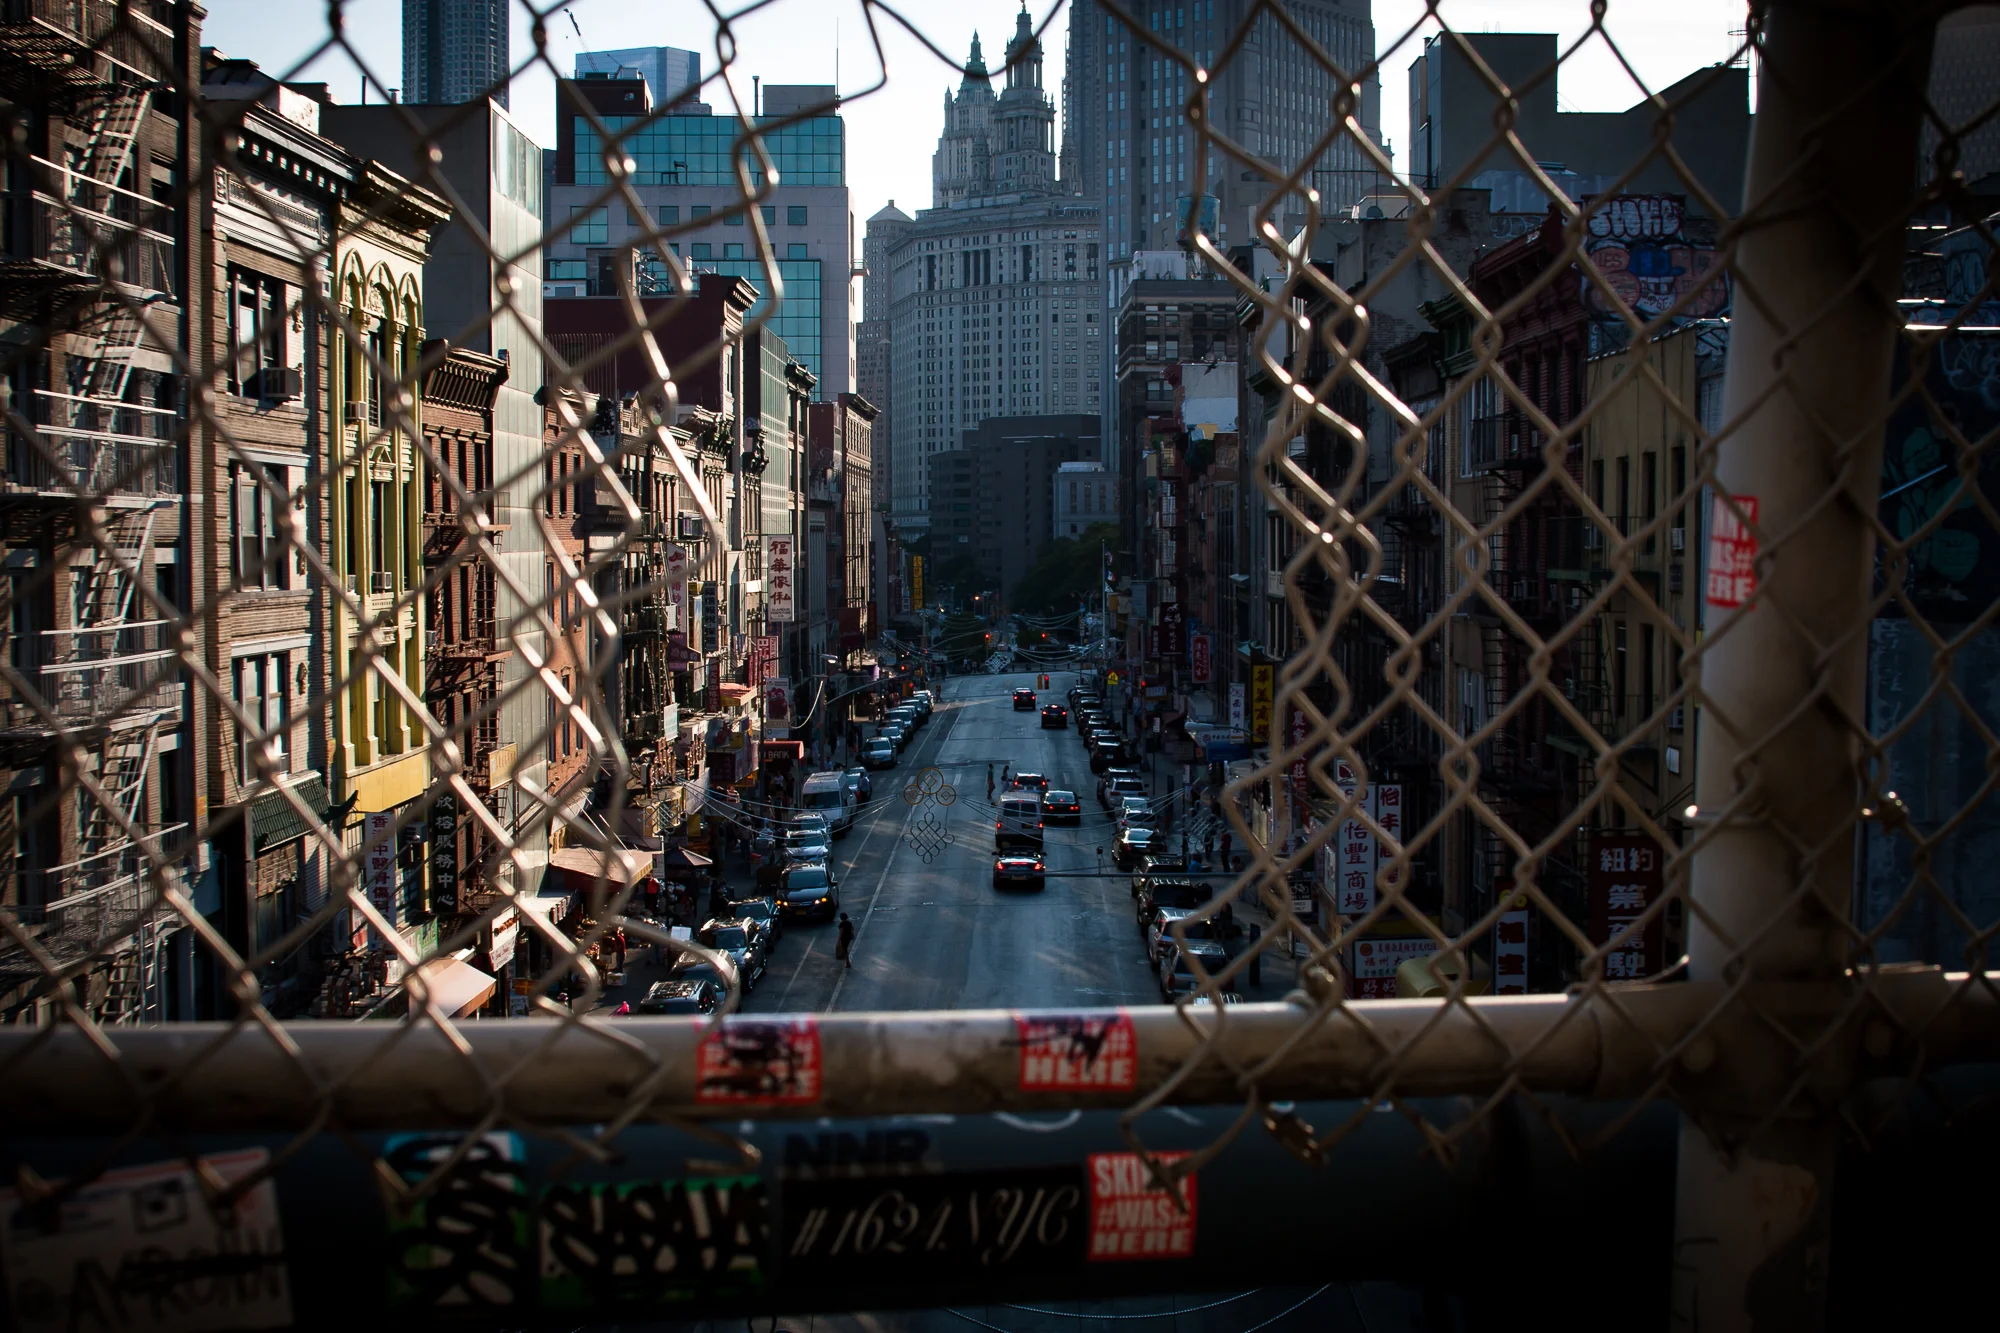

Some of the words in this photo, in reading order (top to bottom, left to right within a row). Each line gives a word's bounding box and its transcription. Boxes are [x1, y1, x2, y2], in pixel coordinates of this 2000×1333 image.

[768, 751, 790, 759] BANK
[1344, 821, 1369, 910] 怡豐商場
[1600, 847, 1654, 872] 紐約
[371, 815, 390, 942] 香中醫骨傷科
[1606, 884, 1647, 984] 第一駕駛
[1024, 1055, 1133, 1085] HERE
[1093, 1228, 1192, 1256] HERE
